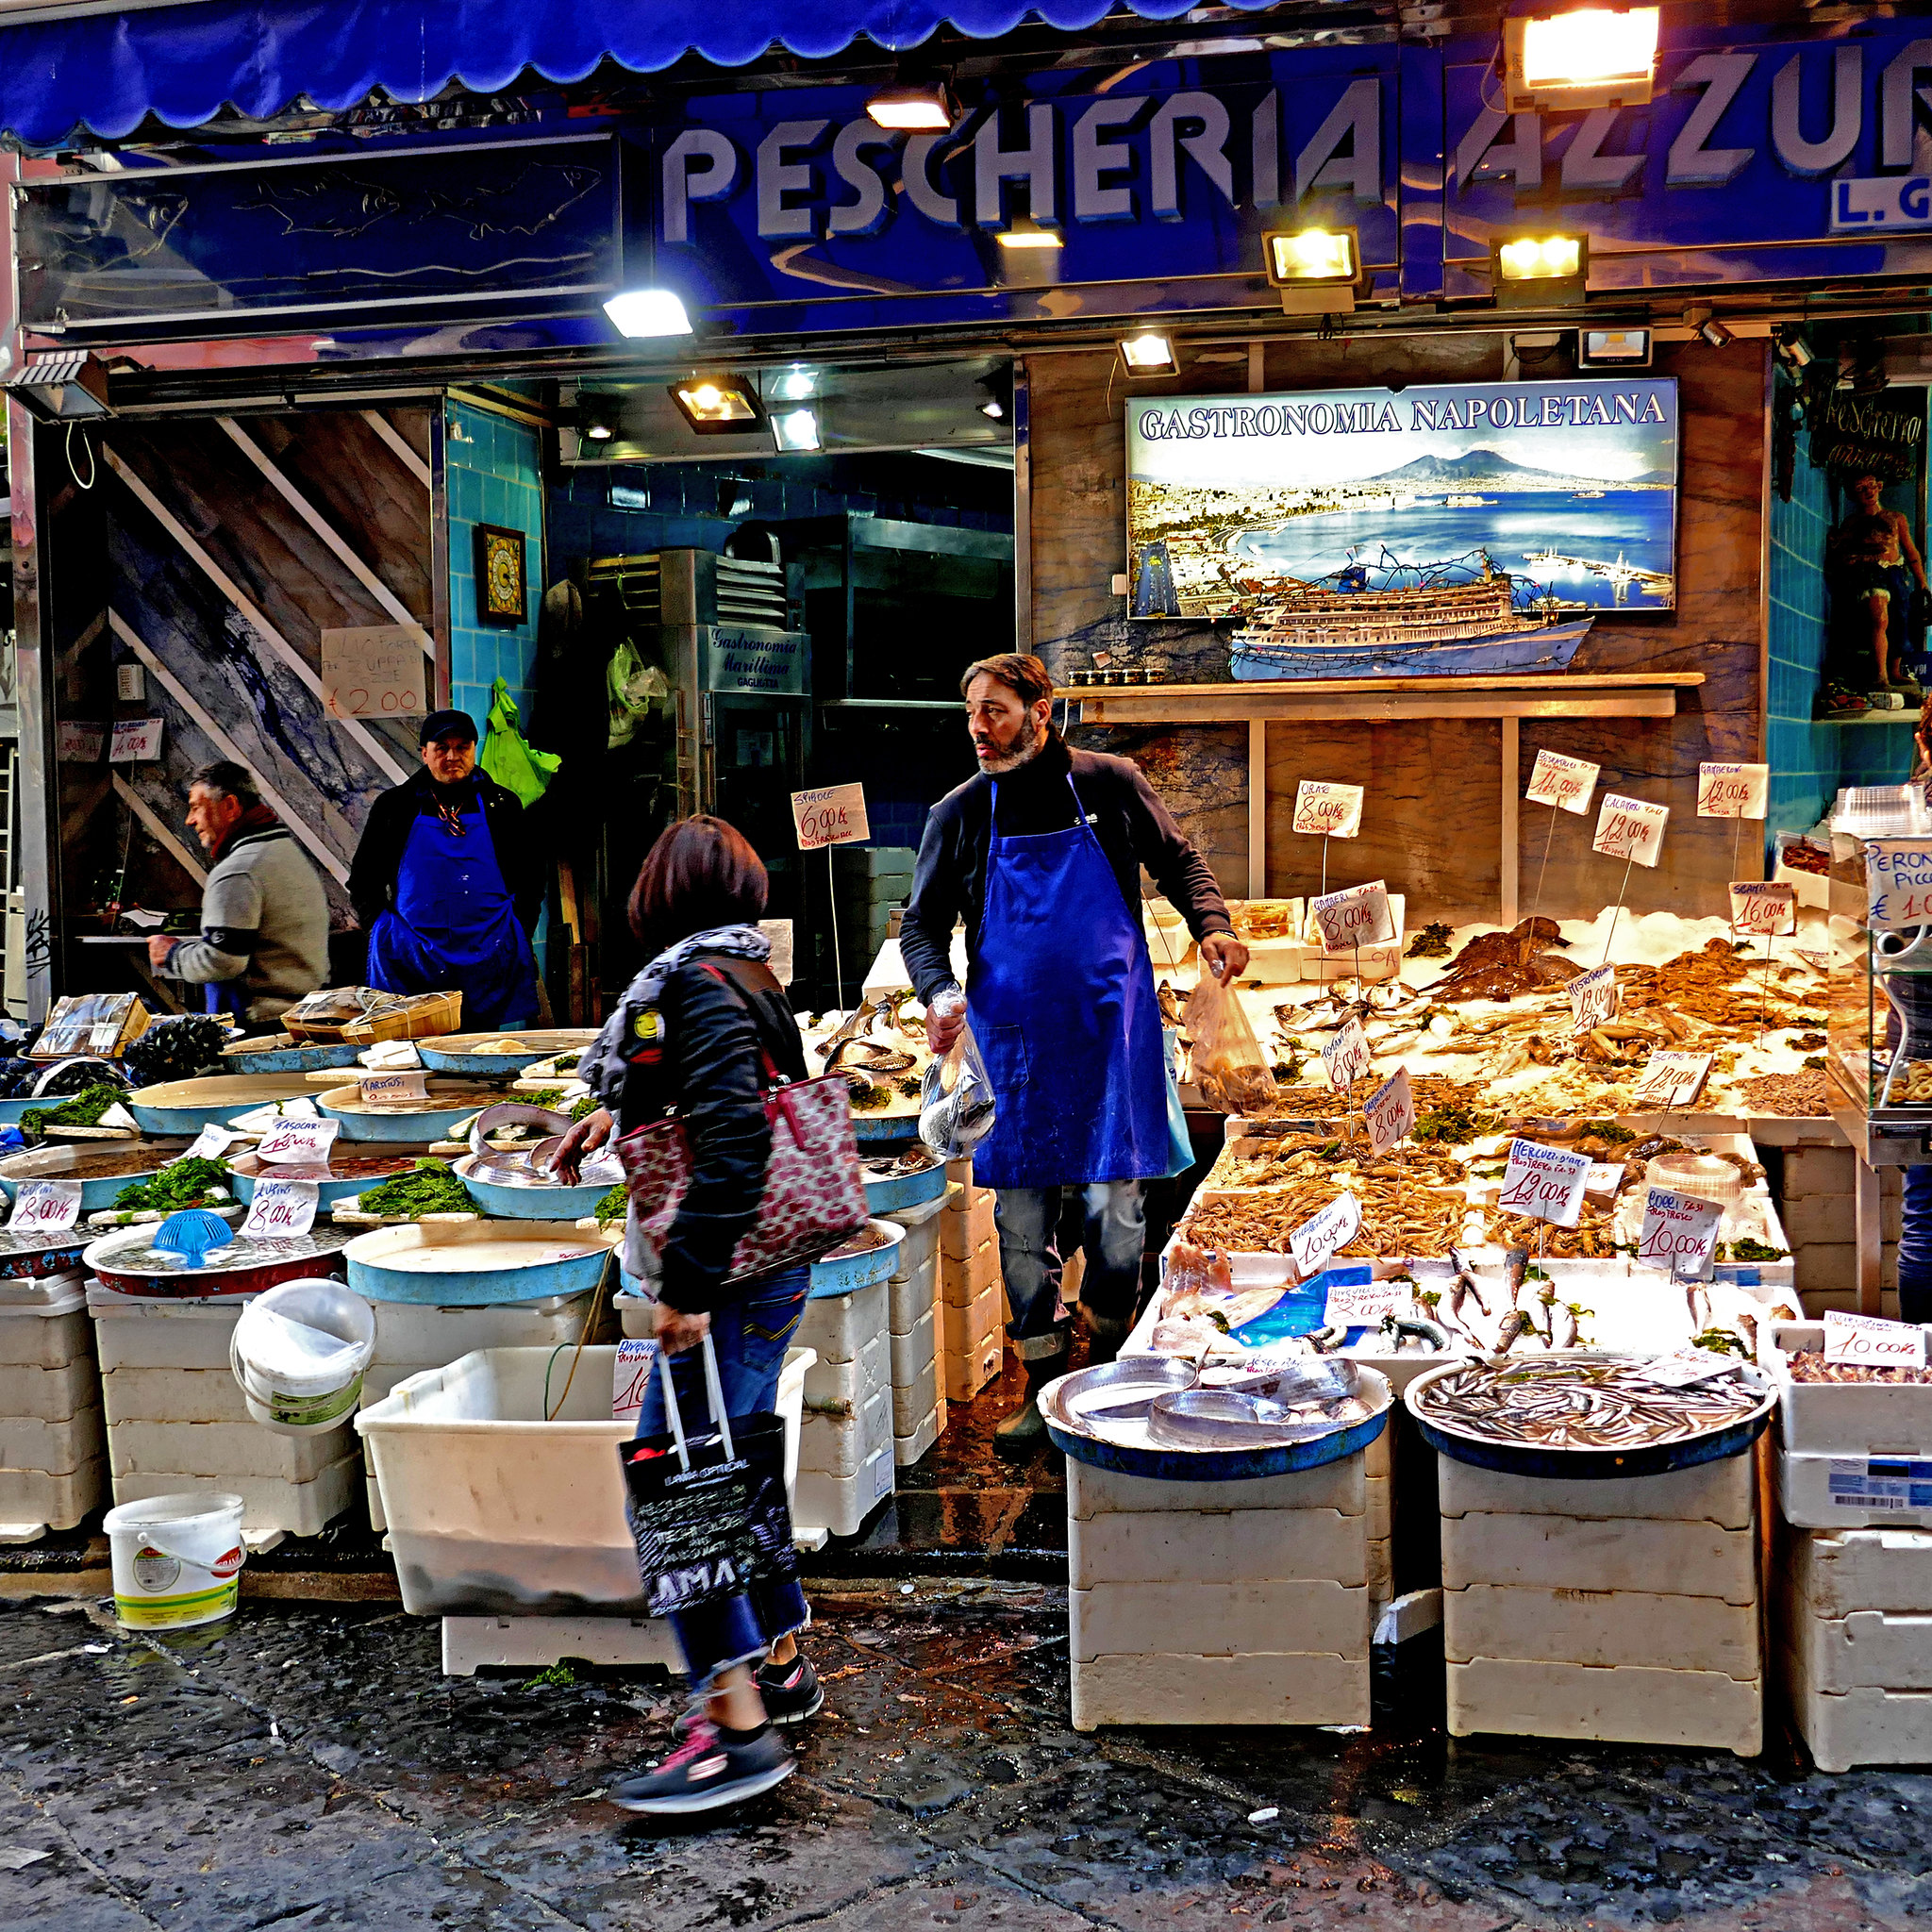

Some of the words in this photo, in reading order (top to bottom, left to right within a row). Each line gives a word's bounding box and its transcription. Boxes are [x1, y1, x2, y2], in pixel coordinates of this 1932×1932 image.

[662, 77, 1385, 245] PESCHERIA
[1139, 401, 1402, 441] GASTRONOMIA
[1411, 392, 1667, 430] NAPOLETANA
[711, 627, 797, 654] Gastronomia
[723, 652, 791, 675] Marittima
